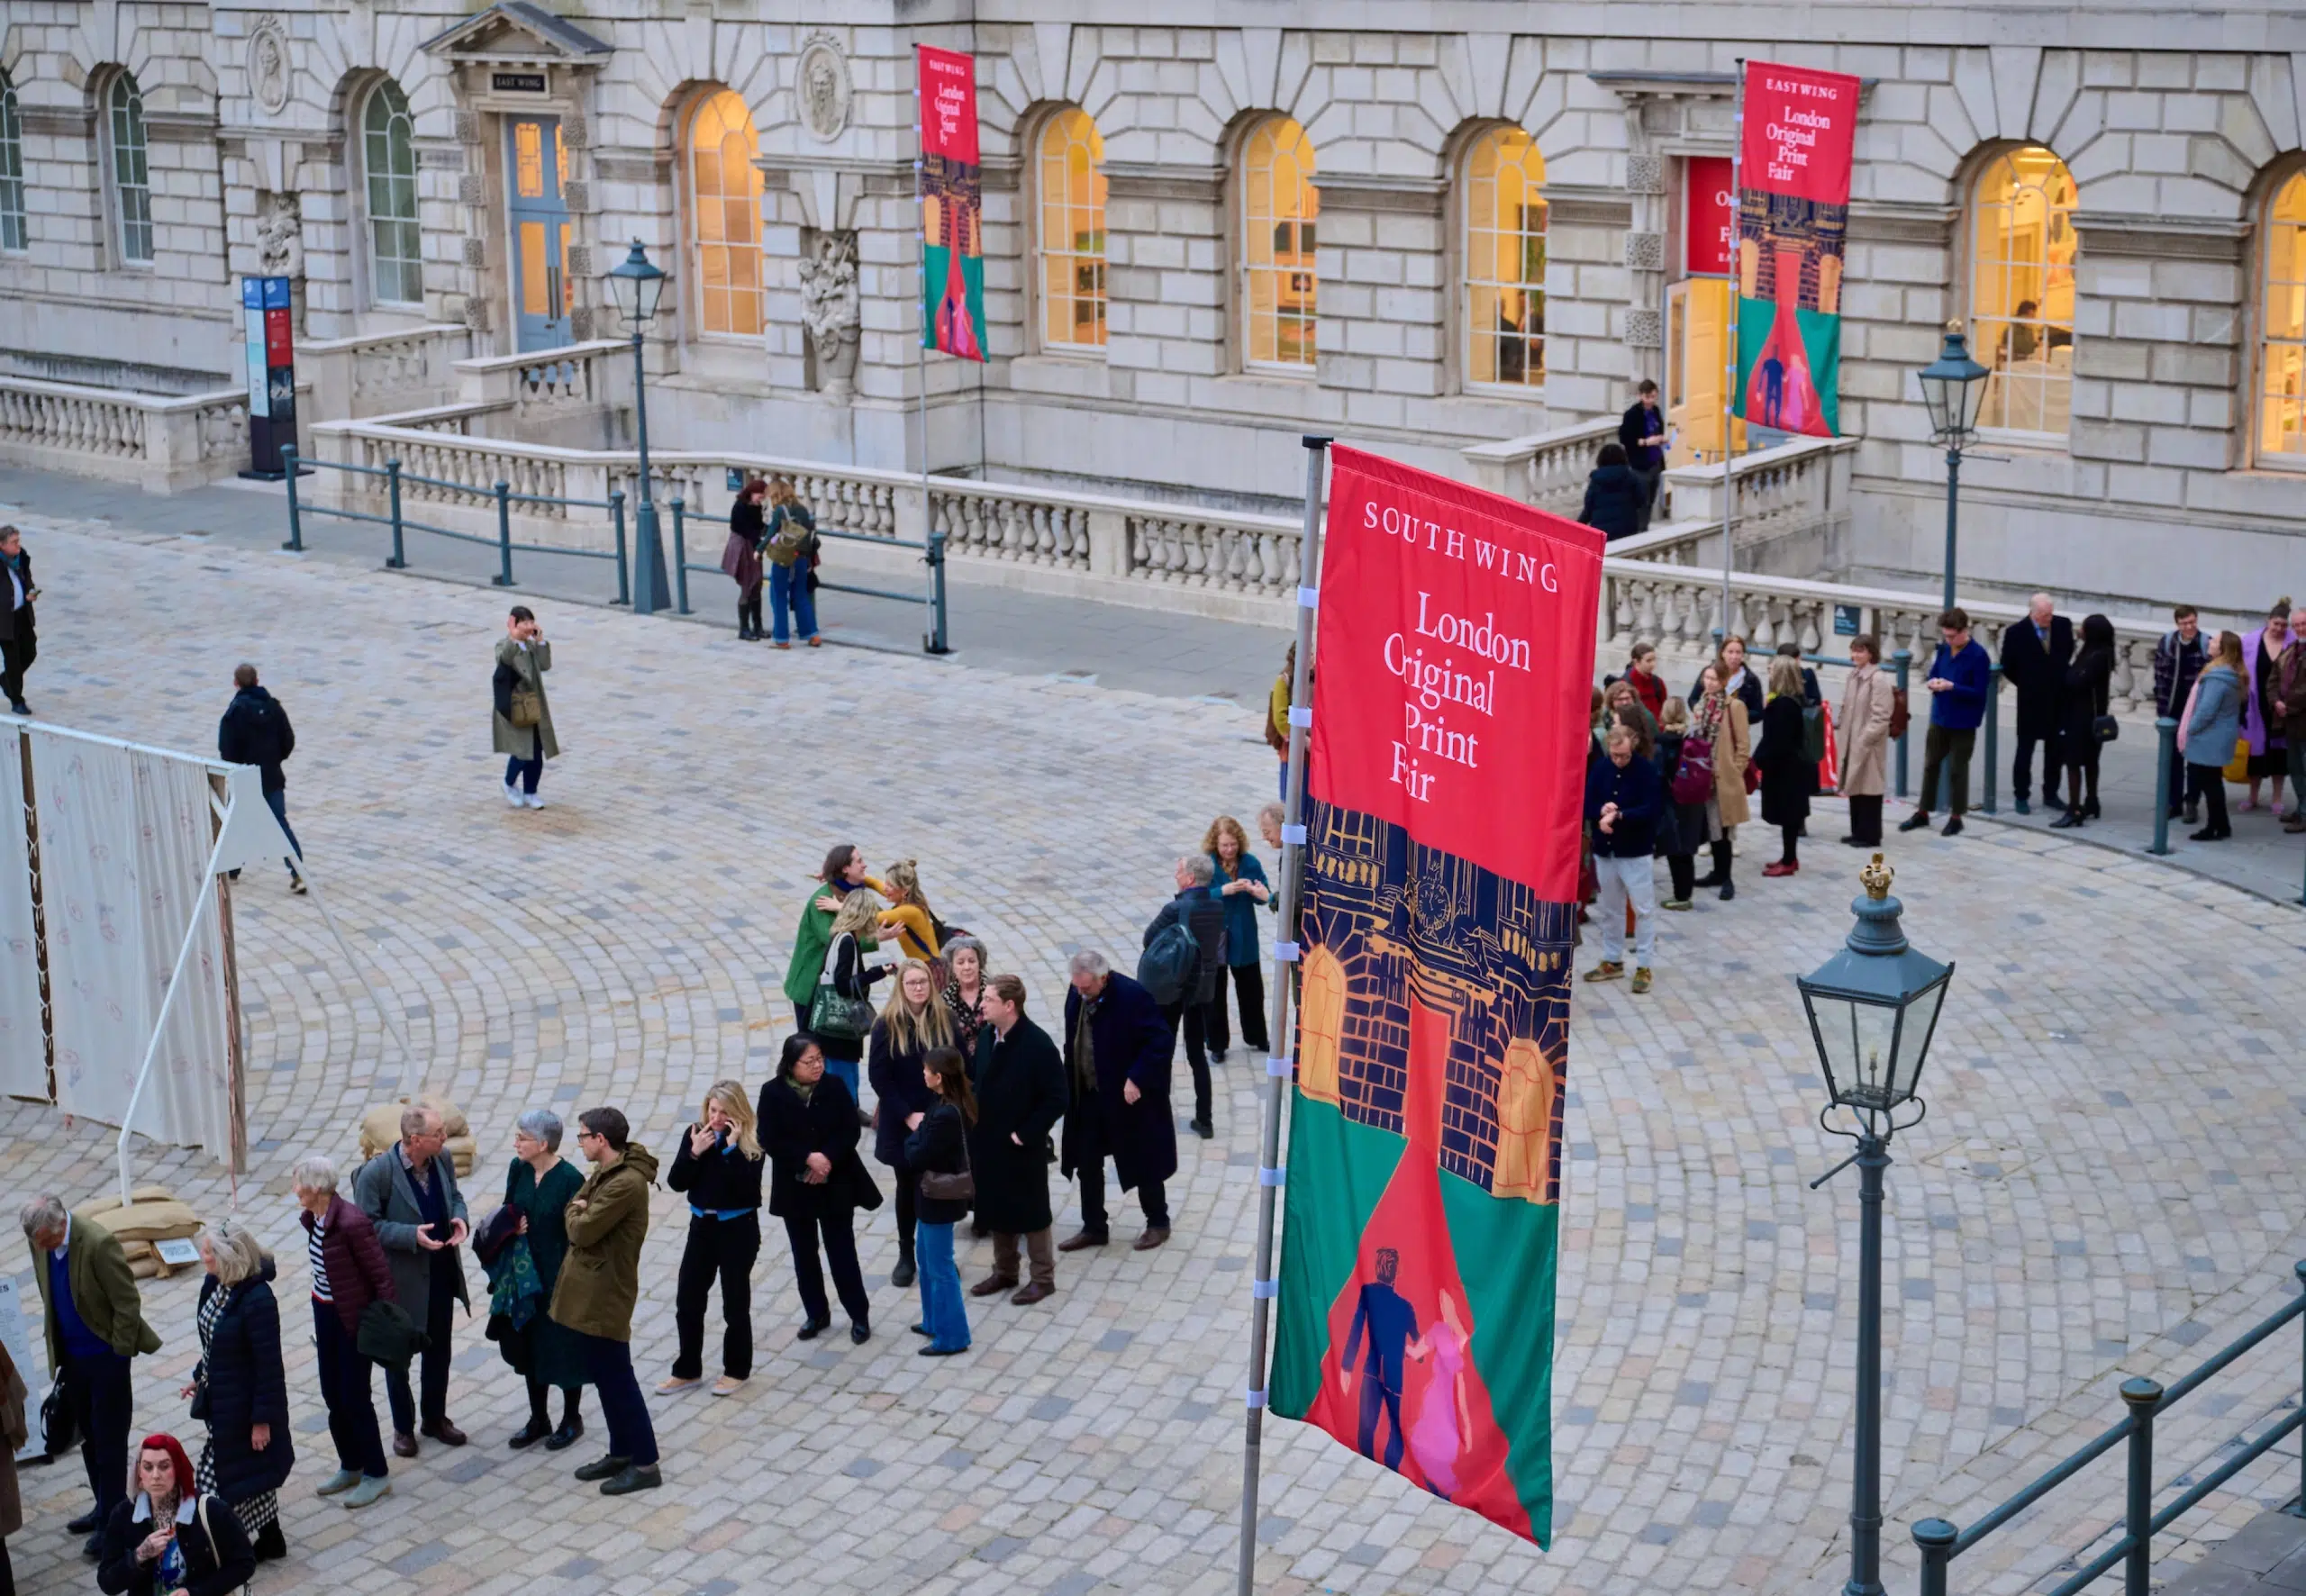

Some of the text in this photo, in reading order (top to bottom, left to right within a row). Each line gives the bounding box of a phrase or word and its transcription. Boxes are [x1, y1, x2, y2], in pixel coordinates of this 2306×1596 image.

[496, 77, 540, 87] EAST WING
[938, 82, 966, 102] London
[1766, 78, 1838, 100] EAST WING
[1784, 105, 1830, 130] London
[1766, 122, 1816, 149] Original
[1777, 146, 1808, 167] Print
[1768, 162, 1794, 181] Fair
[1364, 501, 1558, 593] SOUTH WING
[1415, 591, 1531, 673] London
[1385, 632, 1494, 717] Original
[1405, 701, 1479, 768] Print
[1389, 740, 1436, 803] Fir
